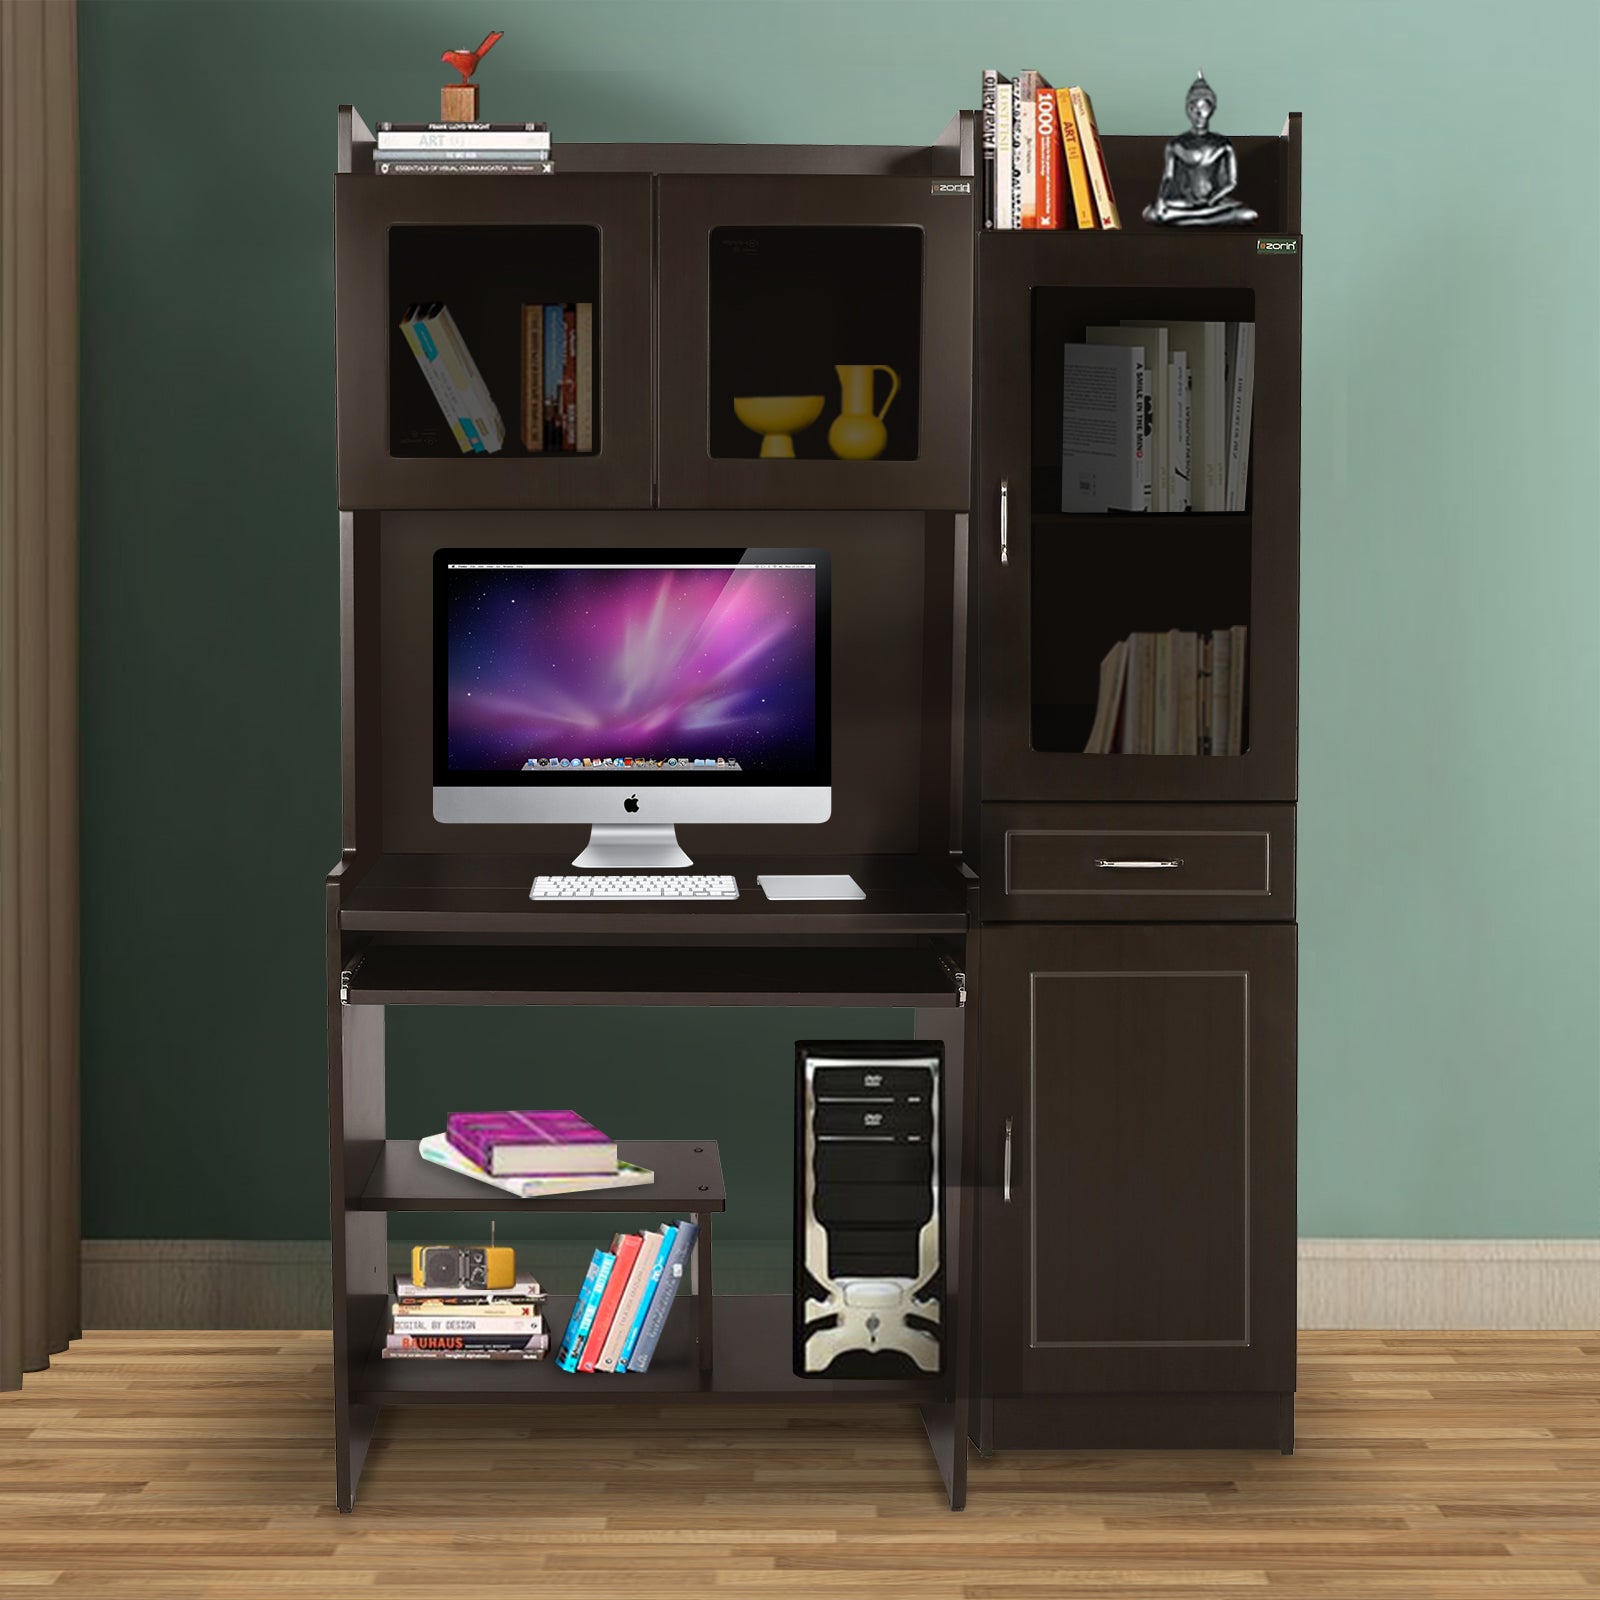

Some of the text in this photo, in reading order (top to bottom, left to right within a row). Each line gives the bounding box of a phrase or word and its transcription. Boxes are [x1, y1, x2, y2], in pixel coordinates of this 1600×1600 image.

[1038, 93, 1053, 135] 1000
[1063, 121, 1077, 144] ART
[418, 135, 446, 147] ART
[1136, 362, 1144, 370] A
[1136, 372, 1144, 399] SMILE
[1136, 402, 1144, 412] IN
[1136, 415, 1144, 431] THE
[431, 1320, 441, 1330] BY
[445, 1320, 476, 1330] DESIGN
[401, 1337, 464, 1350] BAUHAUS
